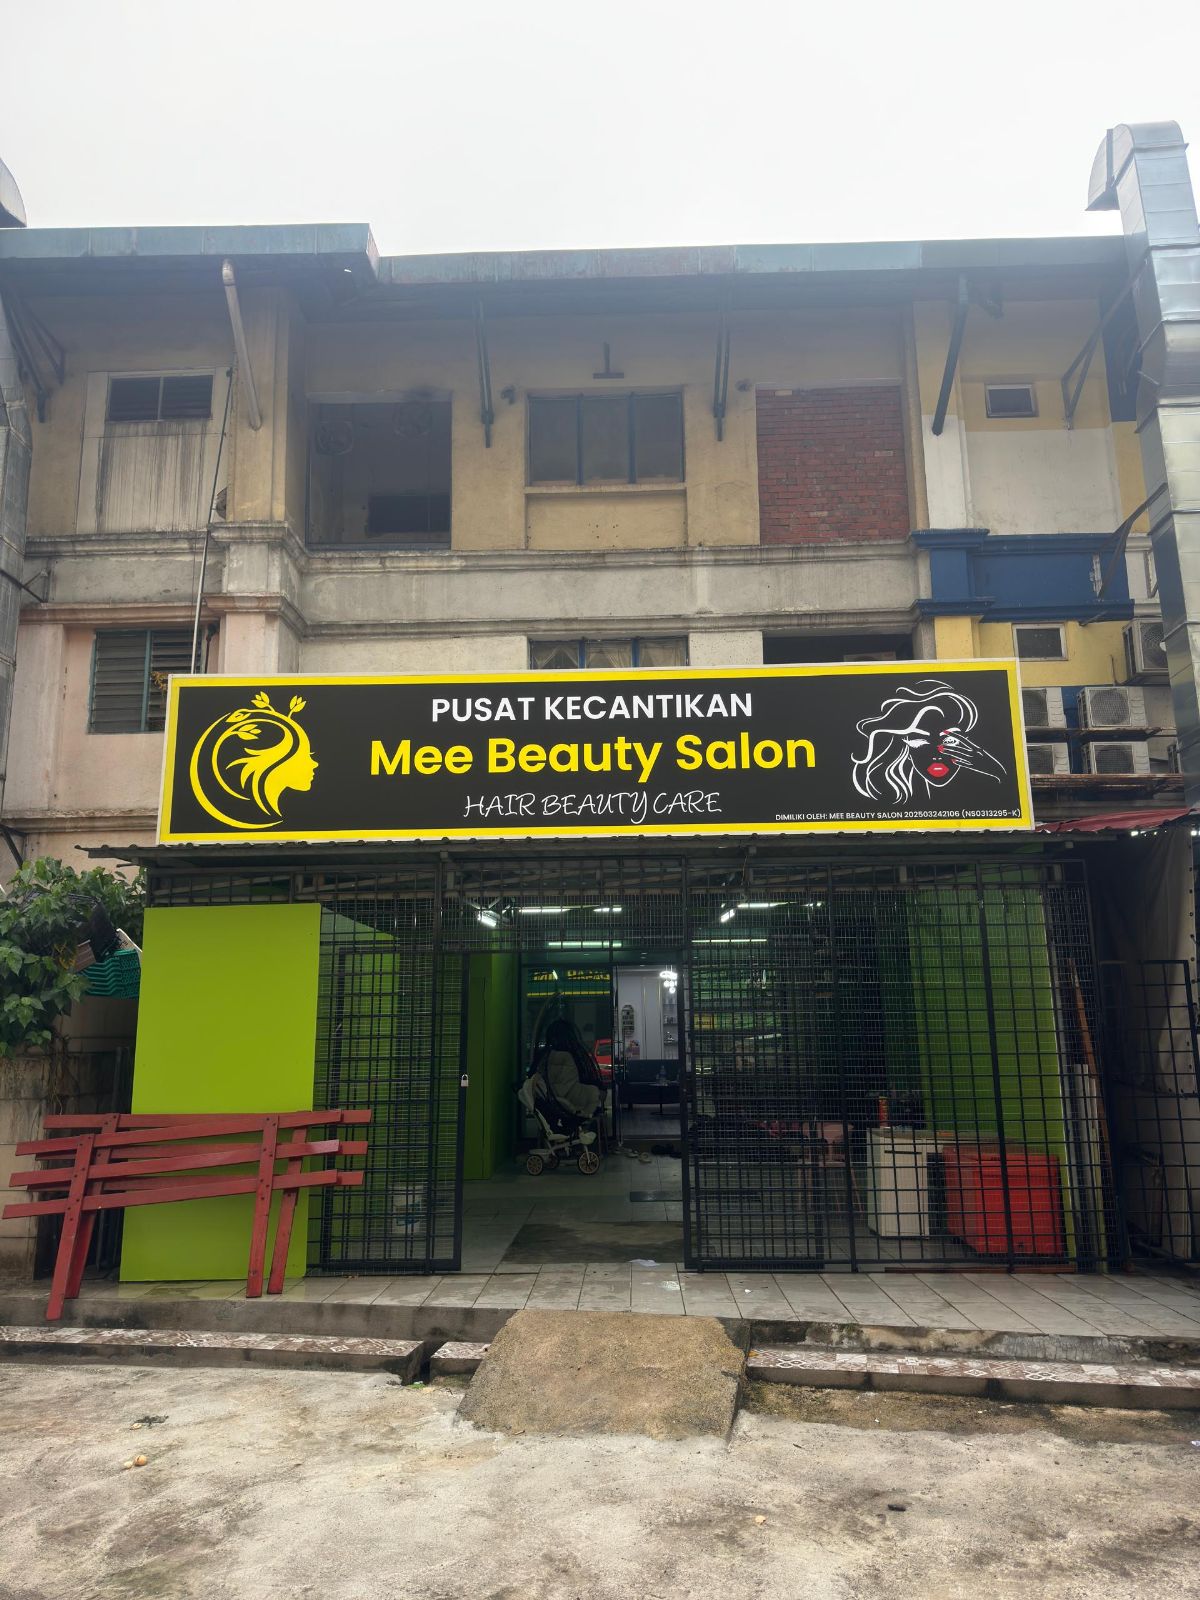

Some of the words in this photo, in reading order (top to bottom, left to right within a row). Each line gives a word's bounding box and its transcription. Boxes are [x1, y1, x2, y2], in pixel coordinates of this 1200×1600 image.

[433, 697, 535, 722] PUSAT
[545, 693, 752, 720] KECANTIKAN
[371, 740, 473, 775] Mee
[488, 737, 662, 783] Beauty
[676, 732, 815, 770] Salon
[464, 793, 535, 817] HAIR
[541, 791, 651, 826] BEAUTY
[653, 790, 721, 814] CARE
[775, 813, 805, 821] DIMILIKI
[829, 812, 844, 820] MEE
[877, 811, 903, 819] SALON
[904, 810, 960, 818] 202503242106
[962, 809, 1021, 818] (NS0313295-K)
